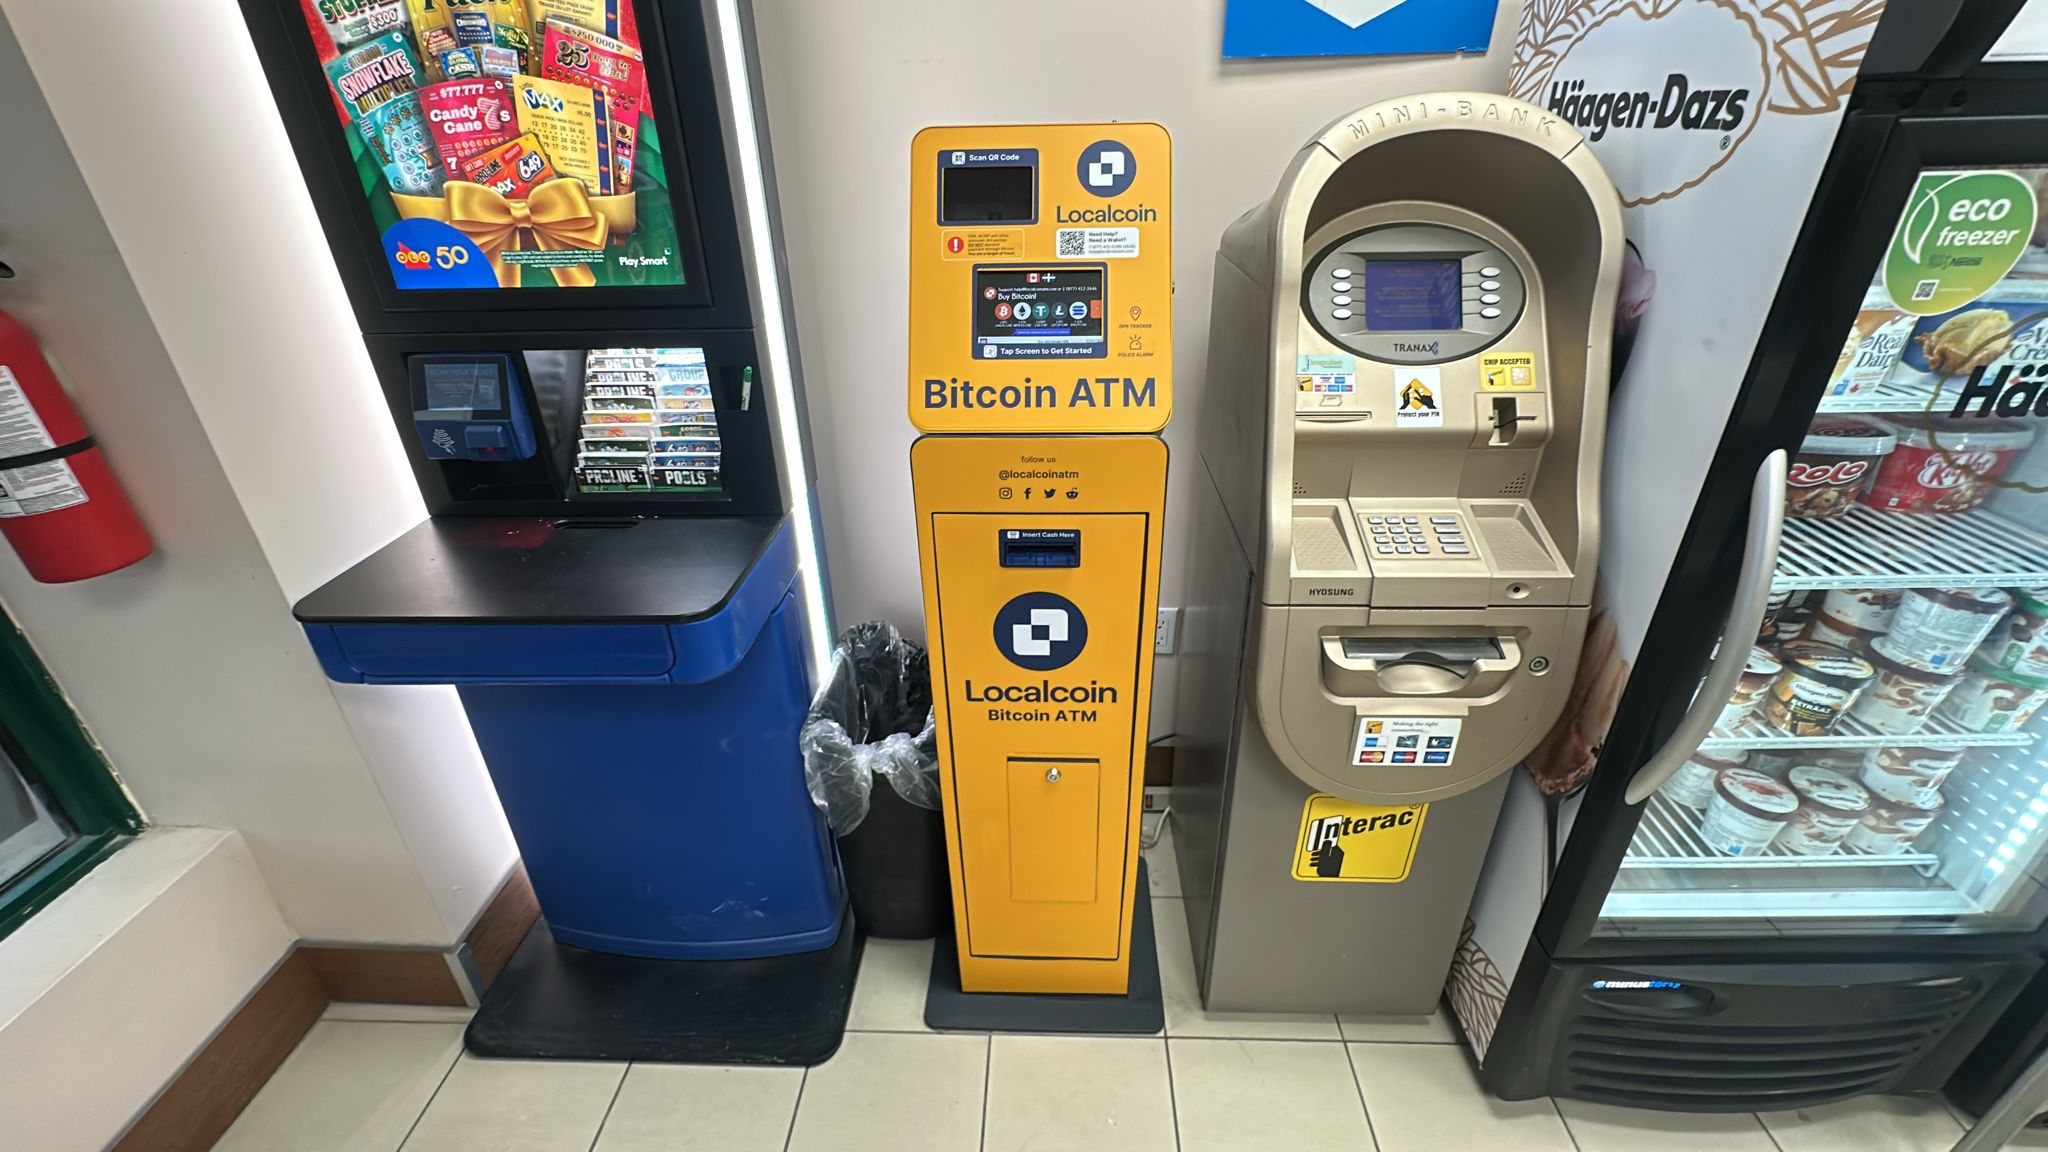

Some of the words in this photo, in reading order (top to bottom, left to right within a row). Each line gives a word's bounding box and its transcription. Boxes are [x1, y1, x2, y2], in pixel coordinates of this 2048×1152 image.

[371, 11, 397, 28] $300
[341, 51, 412, 101] SNOWFLAKE
[448, 63, 476, 75] CASH
[523, 89, 564, 113] MAX
[1547, 74, 1750, 143] Häagen-Dazs
[430, 105, 478, 122] Candy
[443, 120, 483, 134] Cane
[447, 157, 458, 171] 7
[969, 153, 987, 162] Scan
[988, 154, 1000, 162] QR
[1000, 153, 1019, 162] Code
[519, 154, 543, 179] 649
[1056, 204, 1157, 224] Localcoin
[1948, 198, 2012, 222] eco
[1936, 226, 2021, 247] freezer
[396, 251, 431, 264] OLG
[436, 245, 469, 270] 50
[619, 256, 639, 268] Play
[640, 256, 669, 266] Smart
[998, 293, 1011, 301] Buy
[1012, 292, 1037, 300] Bitcoin!
[1001, 347, 1014, 356] Tap
[1015, 347, 1040, 355] Screen
[1050, 347, 1065, 355] Get
[1065, 346, 1092, 355] Started
[1393, 341, 1439, 355] TRANAX
[924, 377, 1057, 409] Bitcoin
[1068, 377, 1156, 408] ATM
[1021, 455, 1045, 463] follow
[585, 469, 638, 484] PROLINE
[664, 470, 707, 485] POOLS
[999, 470, 1079, 481] @localcoinatm
[1309, 588, 1354, 596] HYOSUNG
[965, 679, 1117, 703] Localcoin
[988, 709, 1050, 721] Bitcoin
[1054, 710, 1097, 721] ATM
[1312, 810, 1414, 852] Interac
